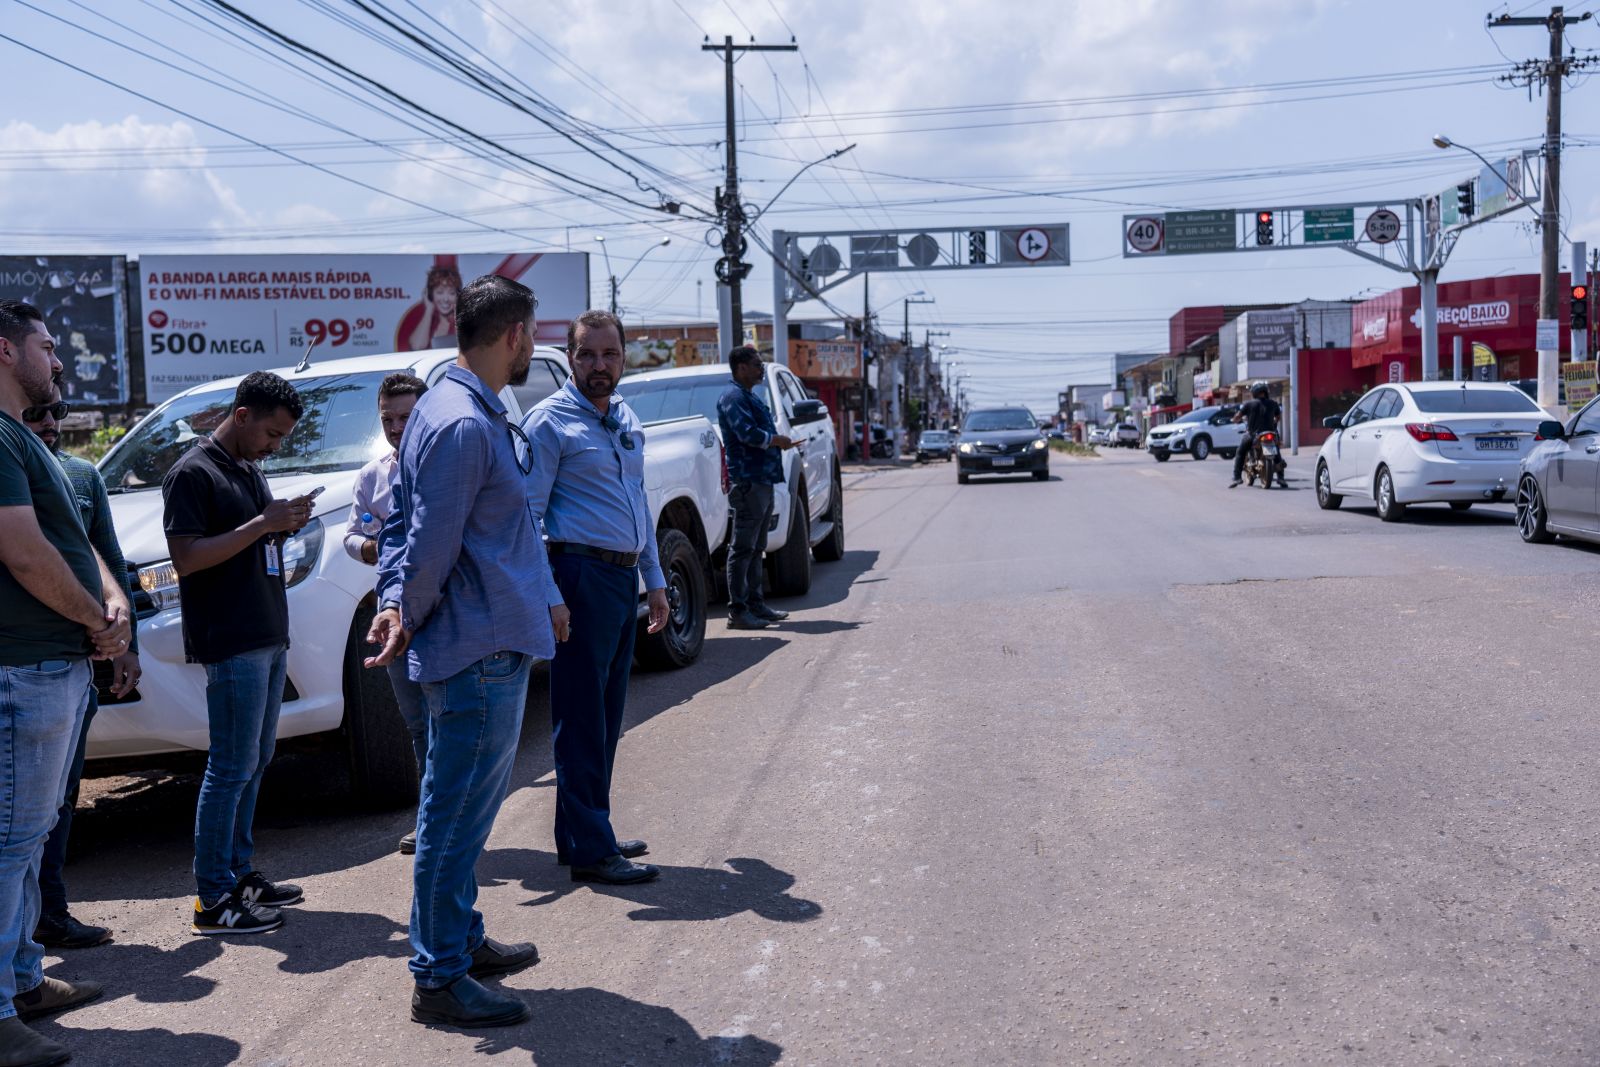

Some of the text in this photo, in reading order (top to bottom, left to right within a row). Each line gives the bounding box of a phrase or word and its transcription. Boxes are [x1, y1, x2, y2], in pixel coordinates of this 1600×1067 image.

[1134, 224, 1155, 239] 40
[148, 268, 372, 284] A BANDA LARGA MAIS RÁPIDA
[149, 283, 411, 299] E O WI-FI MAIS ESTÁVEL DO BRASIL.
[1436, 304, 1508, 324] REÇO BAIXO
[172, 319, 208, 329] Fibra+
[1255, 325, 1285, 336] CALAMA
[151, 333, 265, 355] 500 MEGA
[290, 336, 304, 347] R$
[816, 354, 857, 377] TOP
